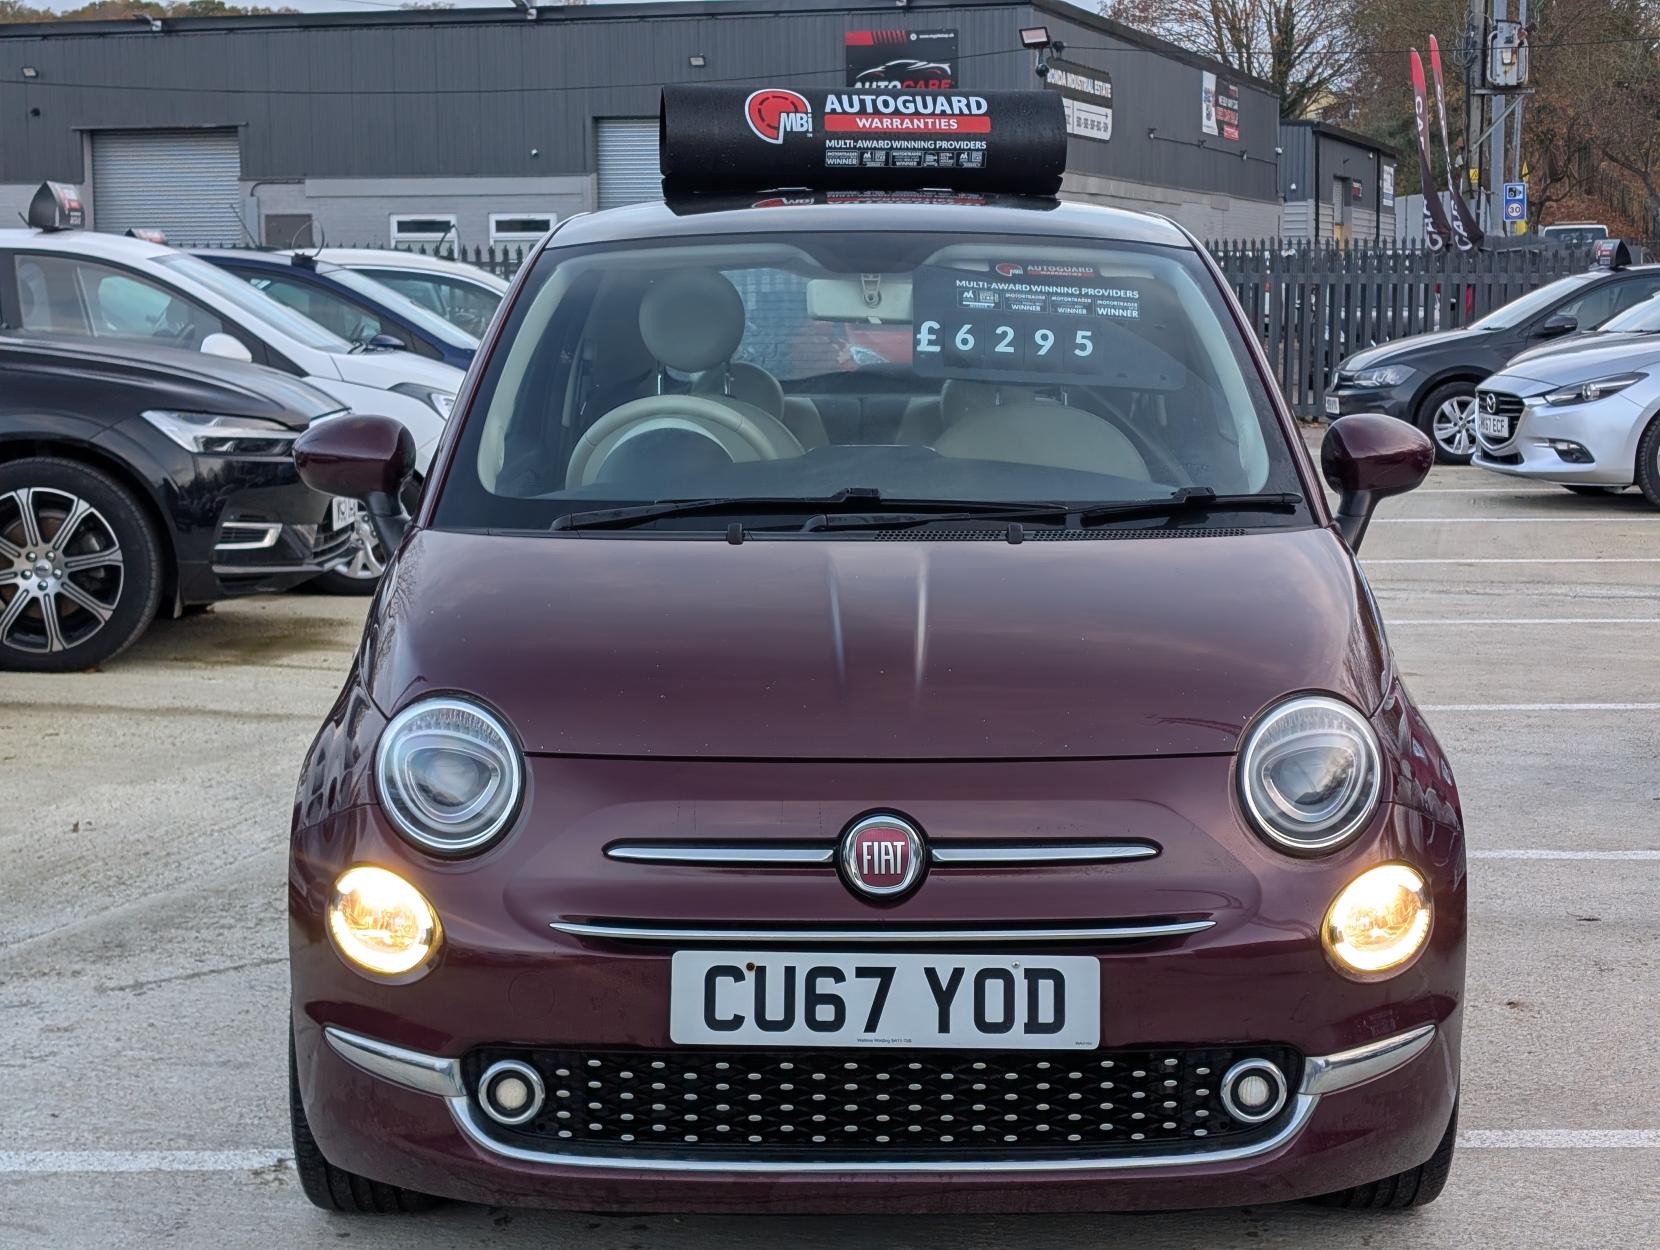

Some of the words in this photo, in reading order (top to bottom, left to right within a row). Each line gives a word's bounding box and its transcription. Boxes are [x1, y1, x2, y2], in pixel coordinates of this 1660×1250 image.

[824, 94, 988, 115] AUTOGUARD
[856, 117, 958, 129] WARRANTIES
[825, 139, 891, 149] MULTI-AWARD
[892, 140, 935, 149] WINNING
[936, 141, 987, 150] PROVIDERS
[1509, 206, 1521, 214] 30
[1027, 264, 1094, 273] AUTOGUARD
[956, 280, 1030, 291] MULTI-AWARD
[1030, 285, 1080, 295] WINNING
[1081, 287, 1139, 299] PROVIDERS
[1011, 303, 1041, 311] WINNER
[1097, 307, 1139, 318] WINNER
[862, 841, 905, 875] FIAT
[703, 964, 897, 1033] CU67
[923, 966, 1067, 1035] YOD
